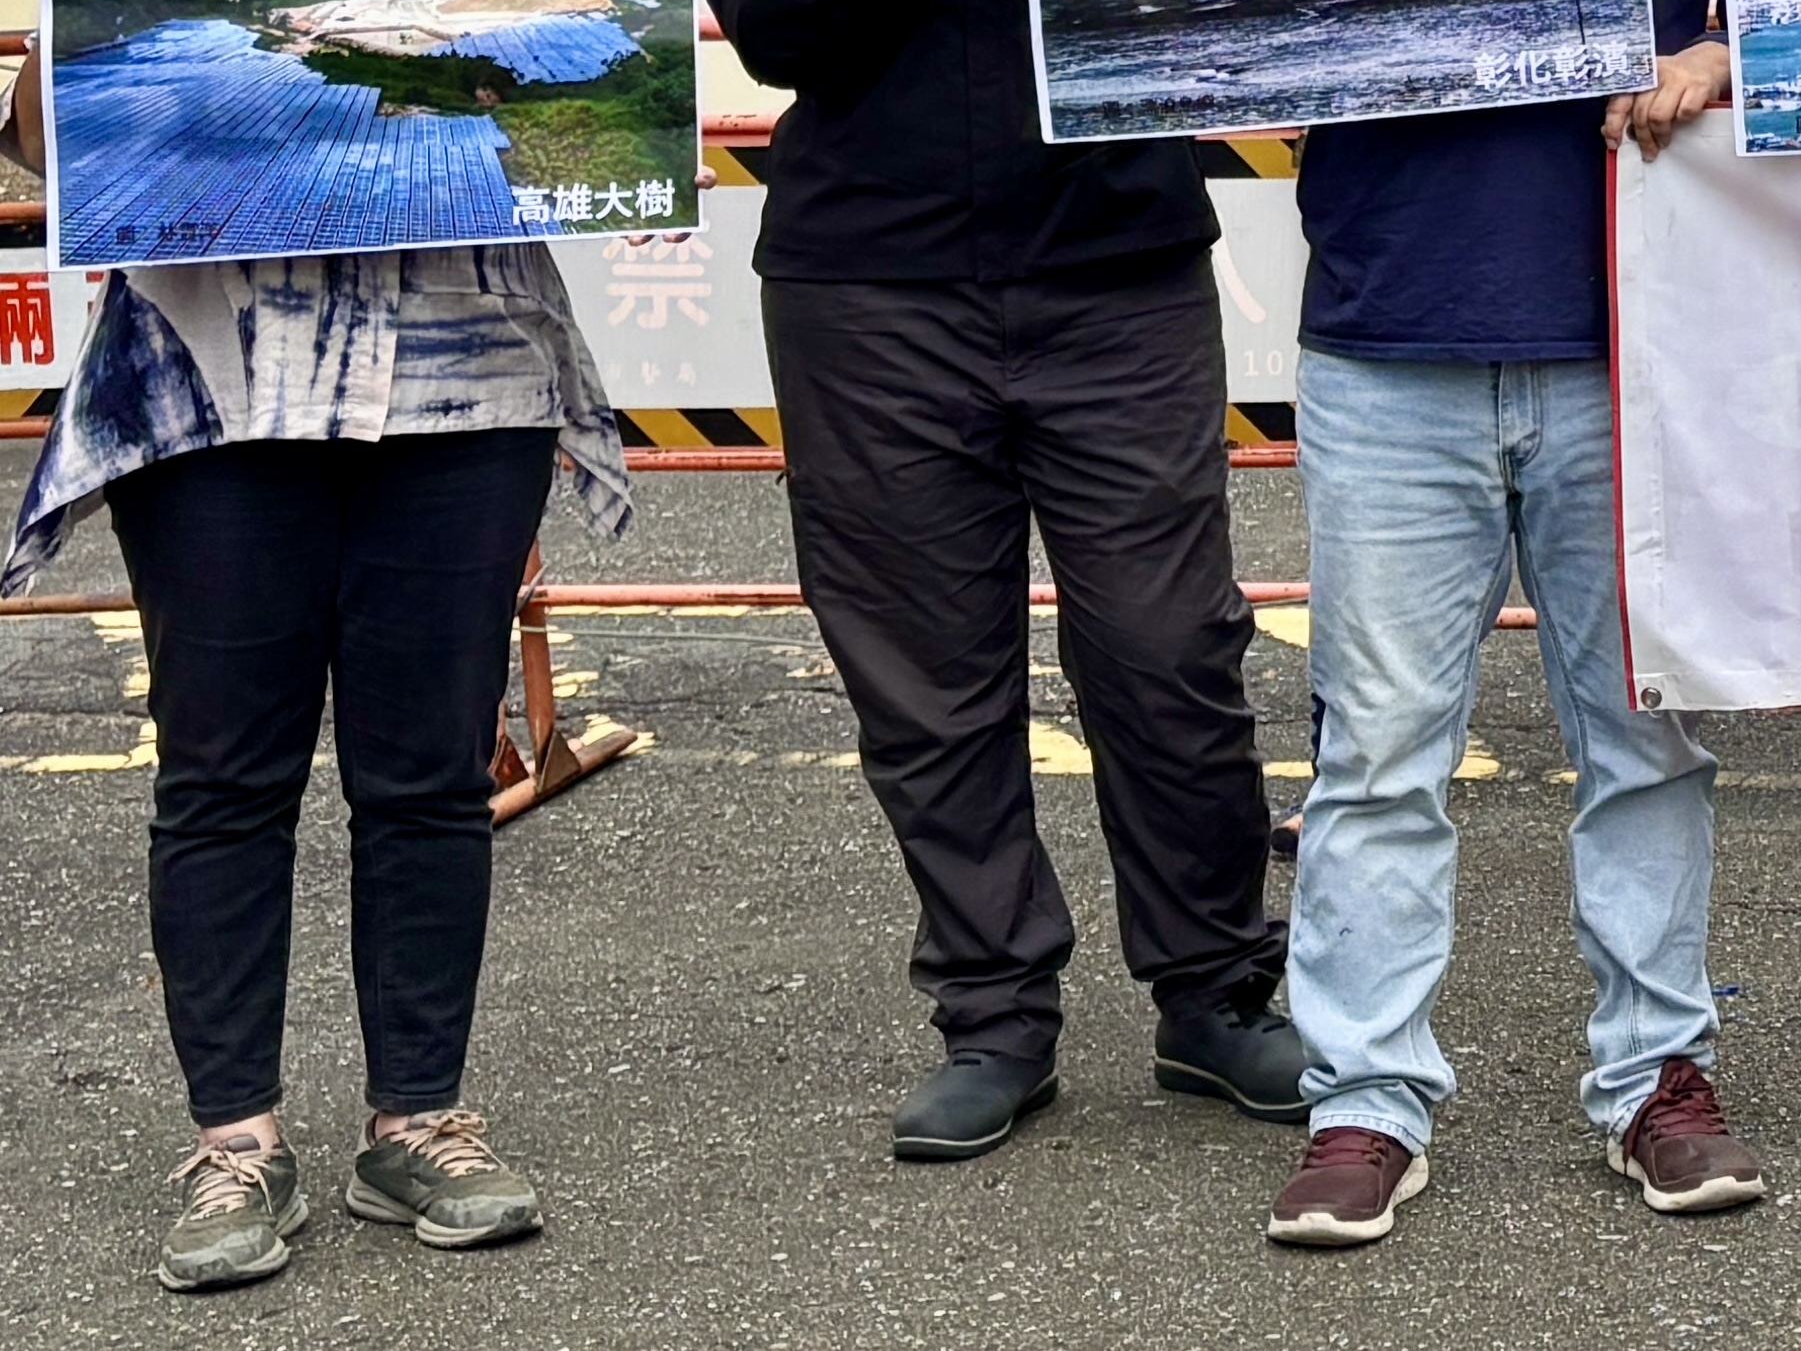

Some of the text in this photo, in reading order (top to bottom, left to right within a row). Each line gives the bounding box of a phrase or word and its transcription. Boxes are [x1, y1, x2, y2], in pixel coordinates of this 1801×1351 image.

[1473, 42, 1631, 91] 彰化彰濱
[512, 178, 675, 224] 高雄大樹
